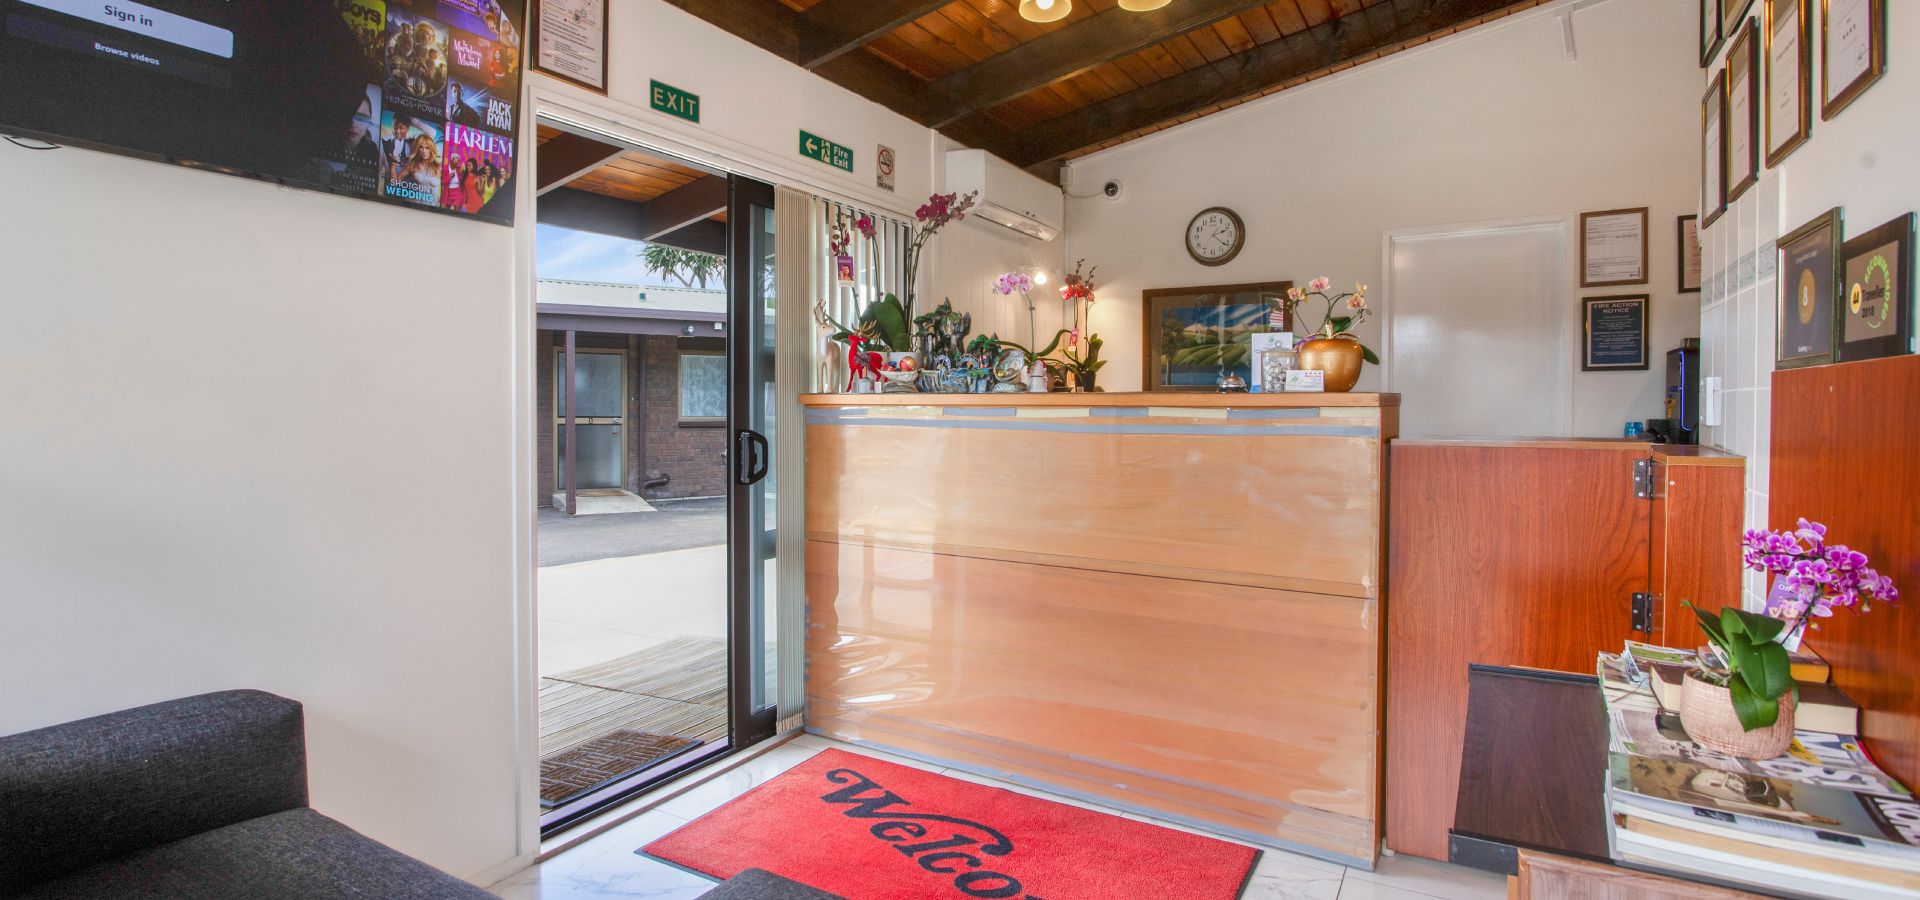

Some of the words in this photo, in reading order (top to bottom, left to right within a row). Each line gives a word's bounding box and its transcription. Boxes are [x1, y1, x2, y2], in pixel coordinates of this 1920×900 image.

[104, 5, 135, 22] Sign
[140, 14, 153, 27] in
[94, 42, 128, 58] Browse
[130, 52, 160, 65] videos
[488, 98, 512, 118] JACK
[653, 87, 697, 116] EXIT
[486, 111, 512, 131] RYAN
[445, 125, 513, 158] HARLEM
[833, 145, 848, 159] Fire
[833, 155, 849, 170] Exit
[386, 184, 434, 202] WEDDING
[390, 178, 431, 193] SHOTGUN
[1864, 255, 1890, 320] RECOMMENDED
[820, 768, 1044, 900] Welco
